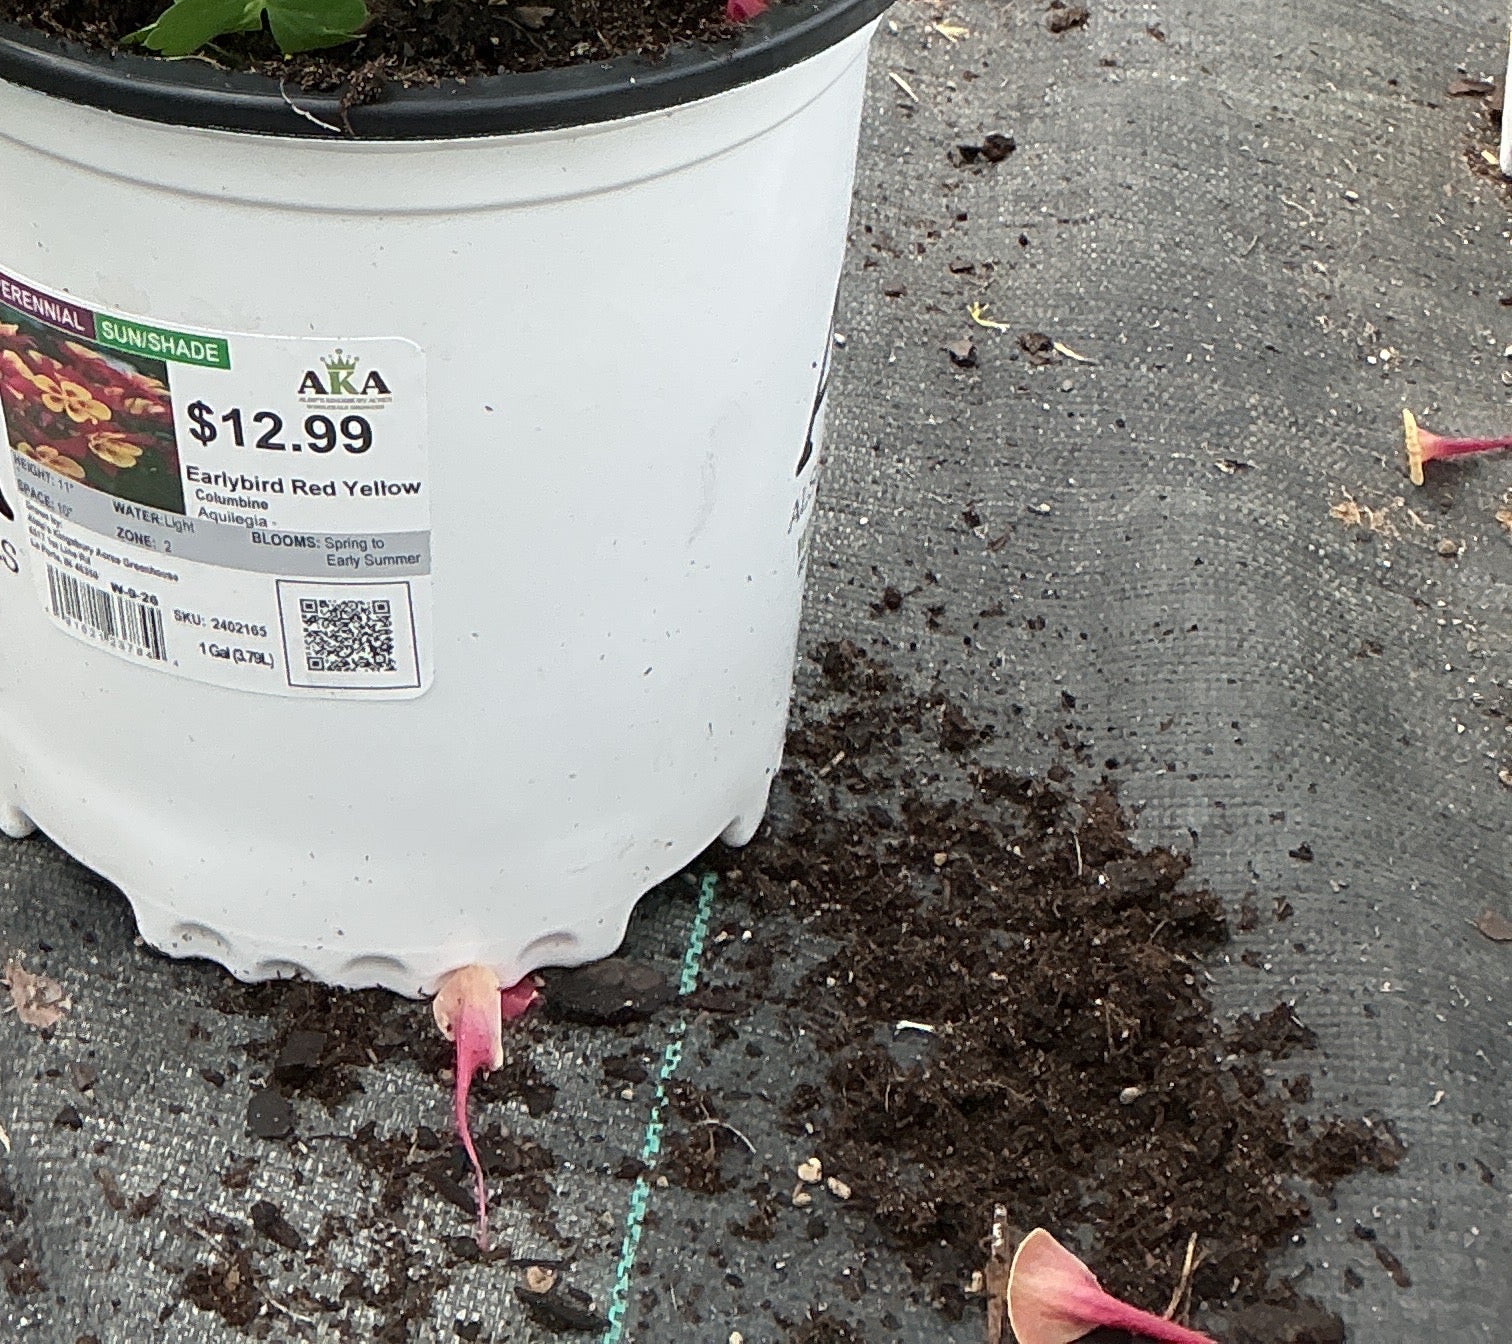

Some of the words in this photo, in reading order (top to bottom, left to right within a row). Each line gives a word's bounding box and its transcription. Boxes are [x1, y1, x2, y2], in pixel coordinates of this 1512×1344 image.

[101, 320, 220, 362] SUN/SHADE
[297, 370, 392, 396] AKA
[187, 399, 374, 454] $12.99
[186, 465, 285, 494] Earlybird
[291, 479, 337, 497] Red
[342, 480, 422, 497] Yellow
[195, 488, 269, 510] Columbine
[197, 506, 268, 529] Aquilegia
[116, 525, 157, 549] ZONE:
[163, 540, 172, 554] 2
[251, 531, 321, 549] BLOOMS:
[324, 536, 368, 552] Spring
[370, 538, 385, 550] to
[326, 554, 361, 569] Early
[363, 552, 421, 567] Summer
[173, 610, 207, 628] SKU:
[210, 617, 268, 638] 2402165
[199, 642, 207, 655] 1
[209, 644, 230, 660] Gal
[232, 647, 274, 669] (3.79L)
